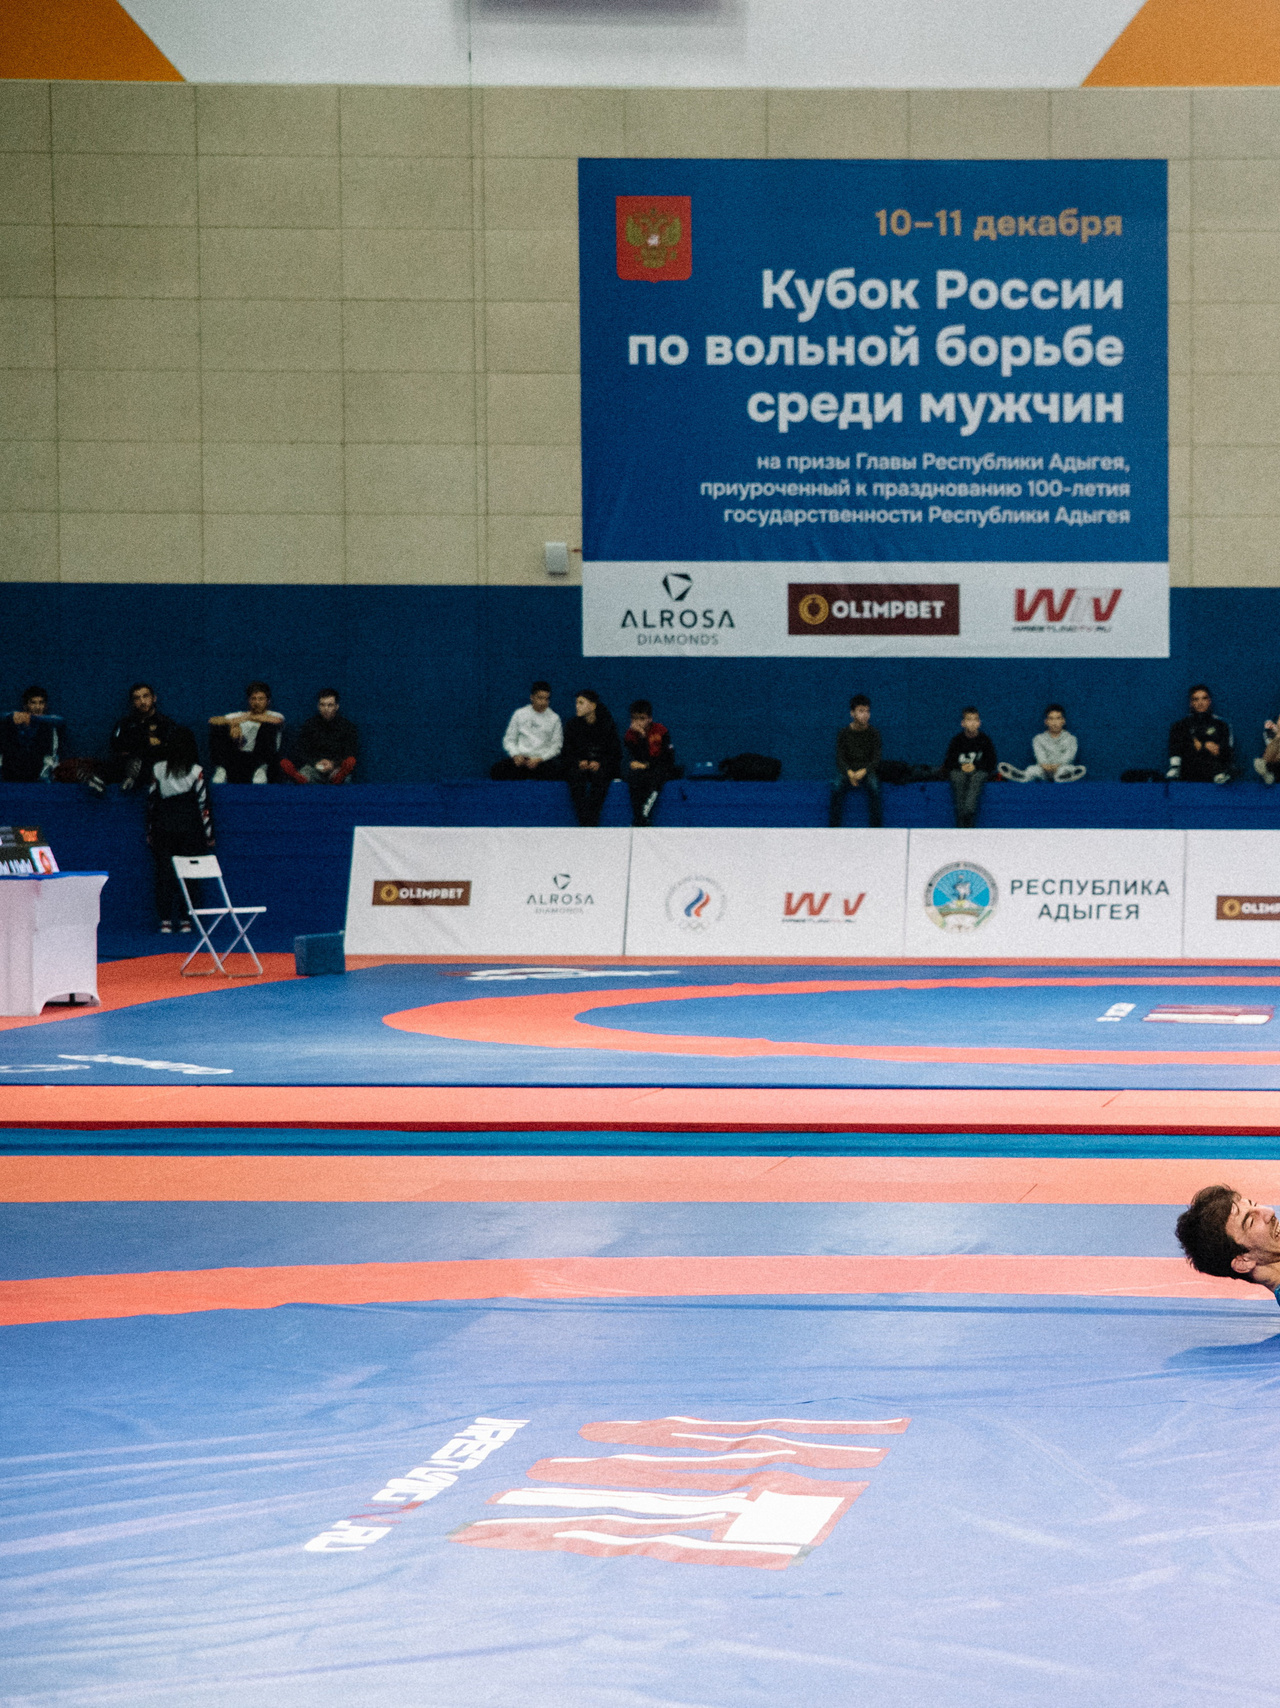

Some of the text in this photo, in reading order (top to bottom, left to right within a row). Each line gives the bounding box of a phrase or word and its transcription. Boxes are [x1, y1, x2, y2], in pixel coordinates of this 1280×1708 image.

[973, 207, 1123, 243] декабря
[762, 268, 1124, 322] Кубок России
[628, 324, 1125, 378] по вольной борьбе
[747, 391, 1124, 438] среди мужчин
[757, 452, 1130, 475] на призы Главы Республики Адыгея,
[701, 480, 1130, 500] приуроченный к празднованию 100-летия
[724, 505, 1131, 528] государственности Республики Адыгея
[620, 608, 736, 629] ALROSA
[832, 600, 946, 620] OLIMPBET
[637, 633, 719, 646] DIAMONDS
[398, 887, 465, 900] OLIMPBET
[1010, 878, 1170, 897] РЕСПУБЛИКА
[526, 893, 595, 905] ALROSA
[1037, 902, 1140, 922] АДЫГЕЯ
